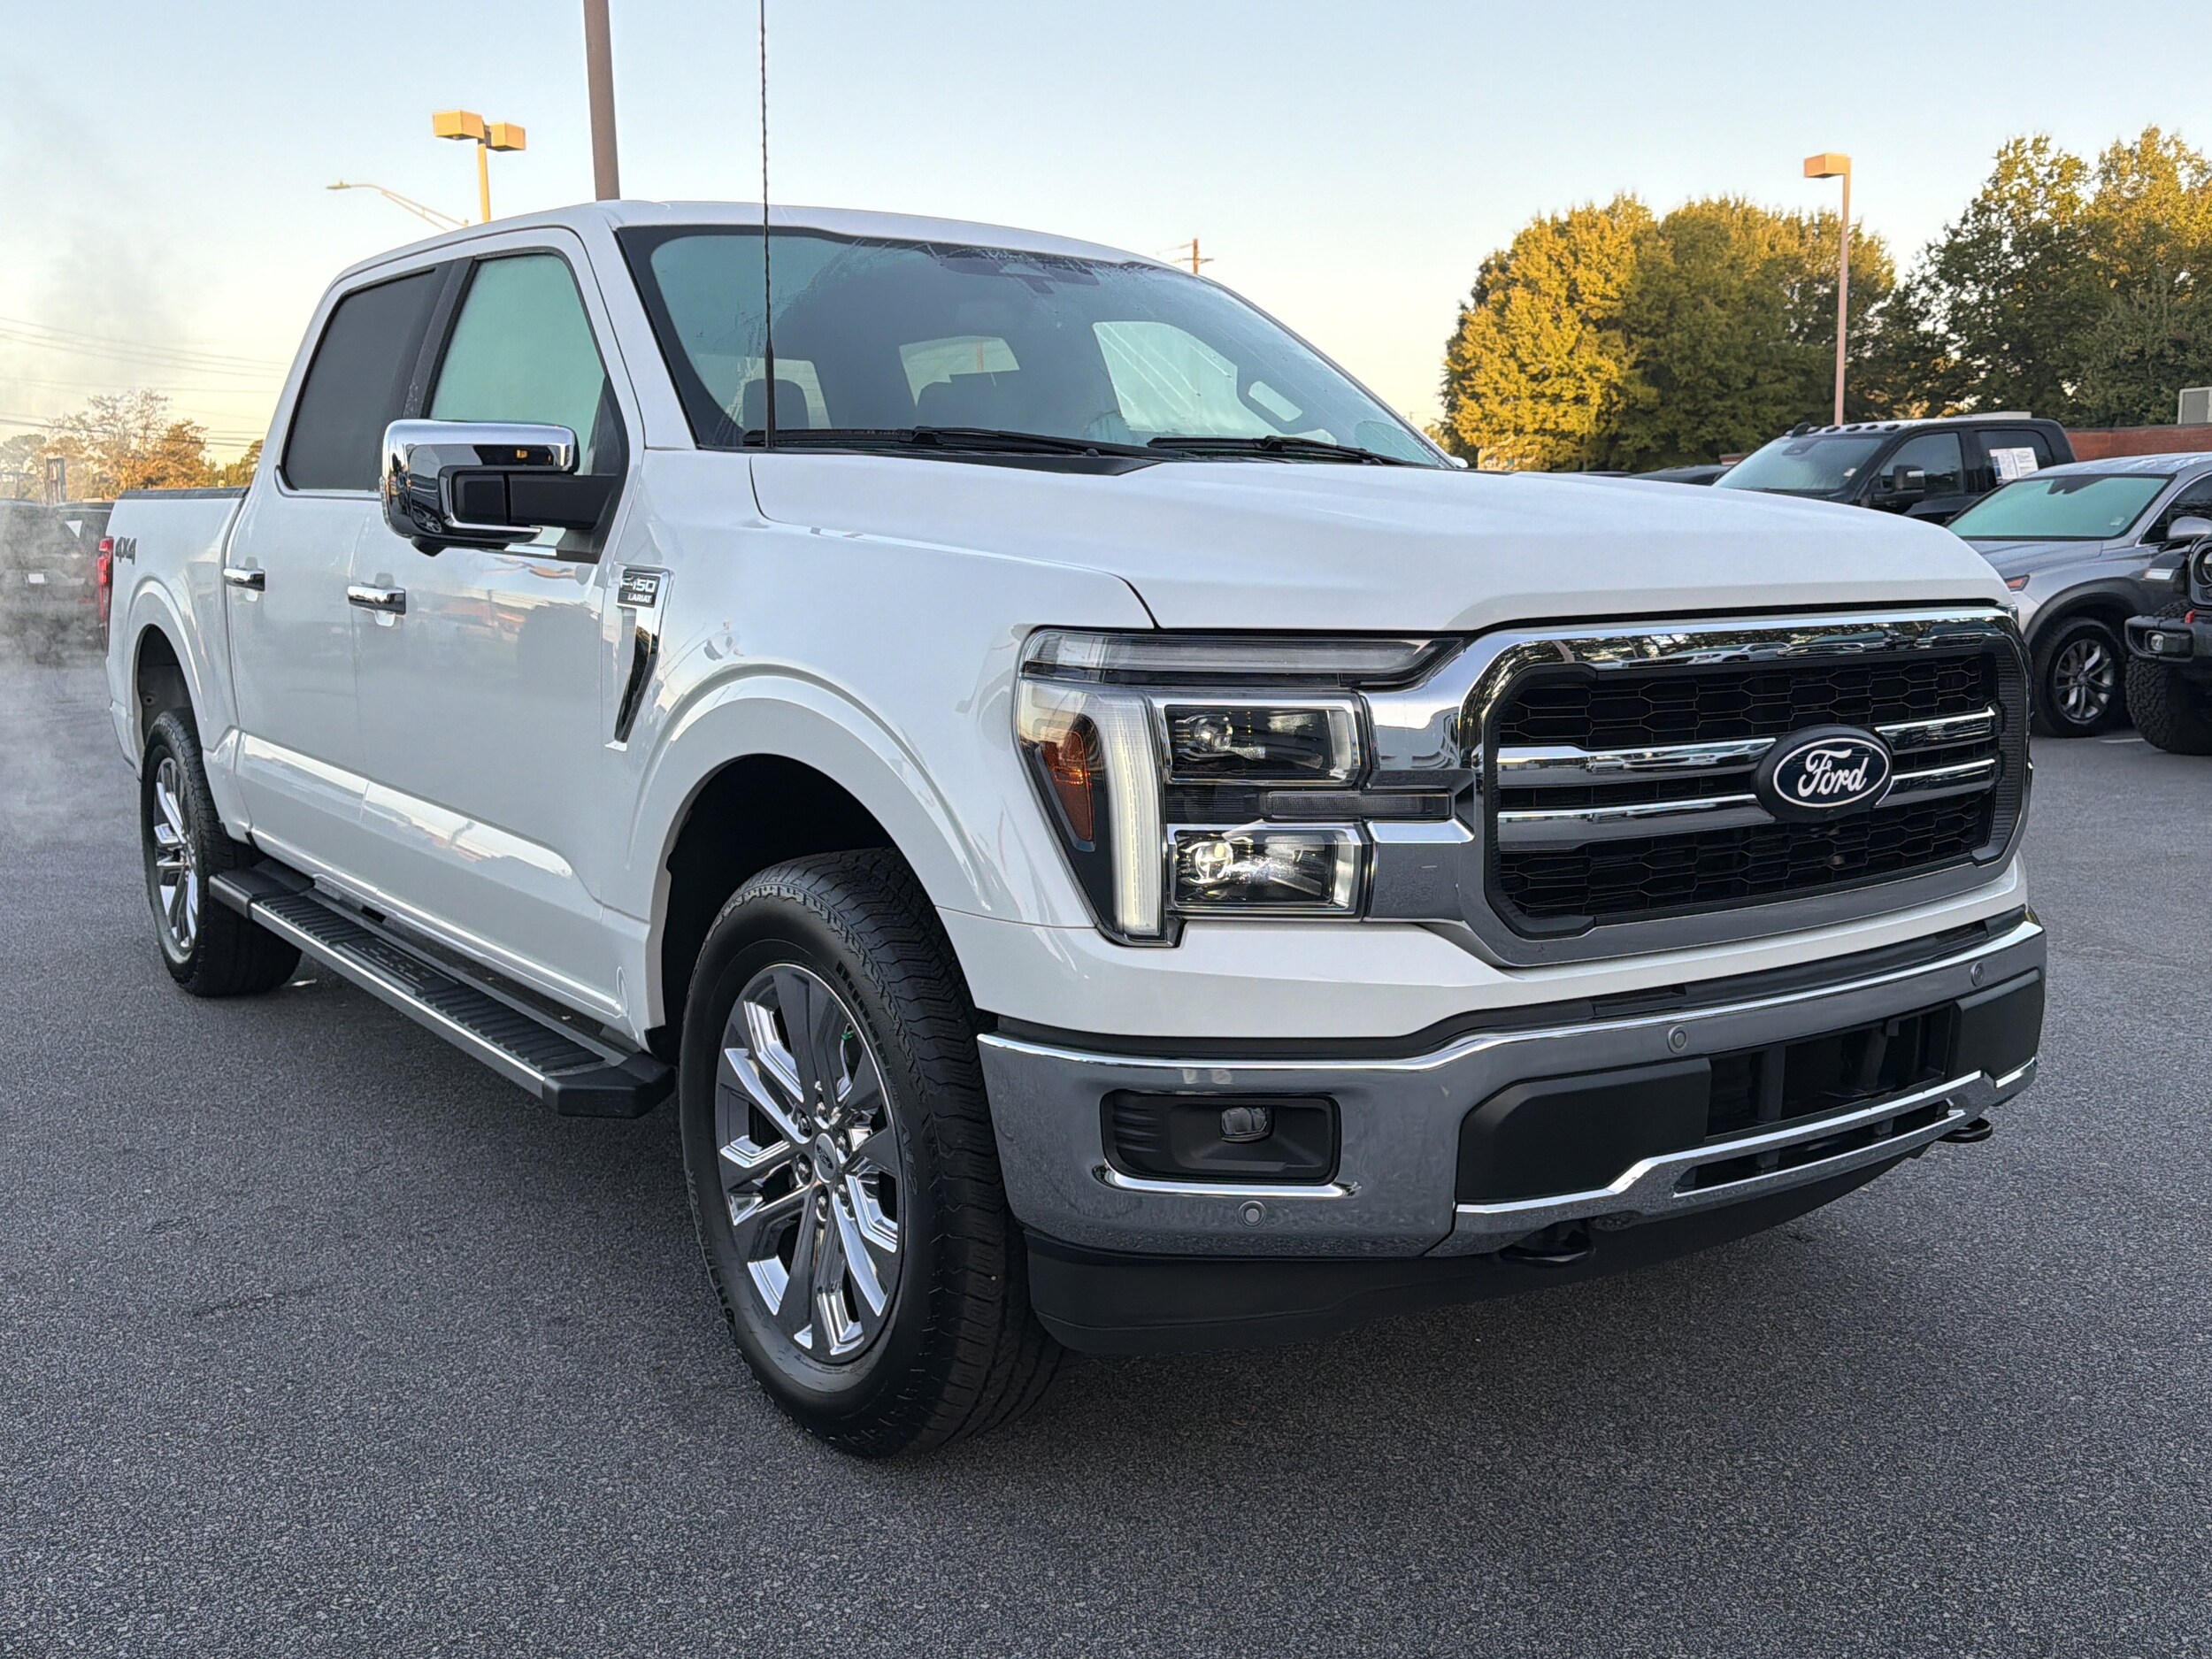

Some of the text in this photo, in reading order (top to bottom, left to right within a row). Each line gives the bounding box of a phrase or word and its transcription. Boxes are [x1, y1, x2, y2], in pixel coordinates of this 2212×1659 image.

[620, 576, 657, 593] F-150
[627, 594, 653, 603] LARIAT
[1798, 749, 1869, 797] Ford
